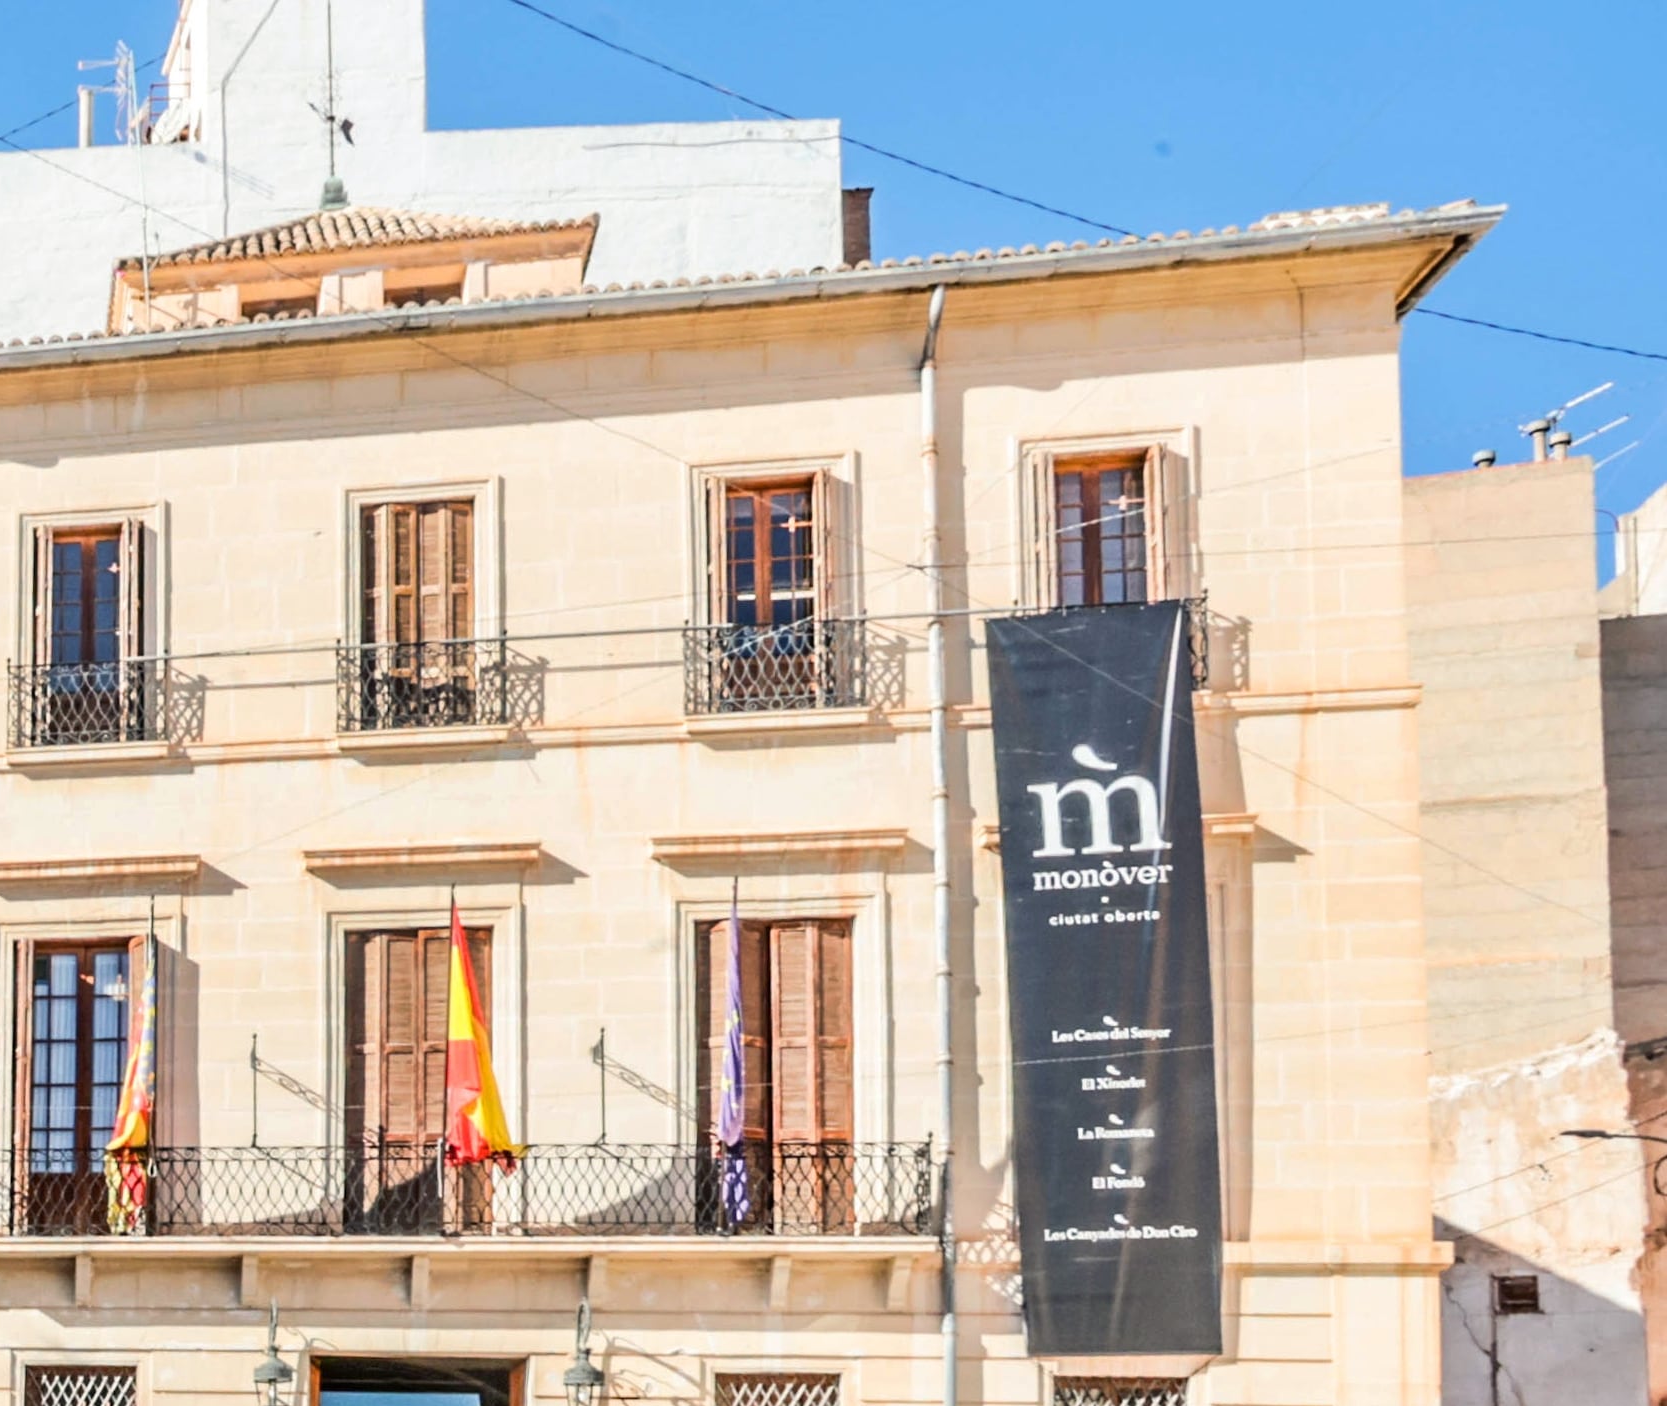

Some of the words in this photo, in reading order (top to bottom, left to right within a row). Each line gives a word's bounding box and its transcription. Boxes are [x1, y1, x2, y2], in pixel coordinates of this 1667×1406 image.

[1033, 861, 1173, 891] monòver
[1049, 912, 1099, 926] ciutat
[1104, 910, 1161, 923] oberta
[1110, 1027, 1129, 1040] del
[1081, 1078, 1095, 1091] El
[1077, 1127, 1094, 1140] La
[1092, 1176, 1106, 1189] El
[1126, 1226, 1142, 1239] de
[1142, 1226, 1169, 1239] Don
[1170, 1225, 1198, 1238] Ciro
